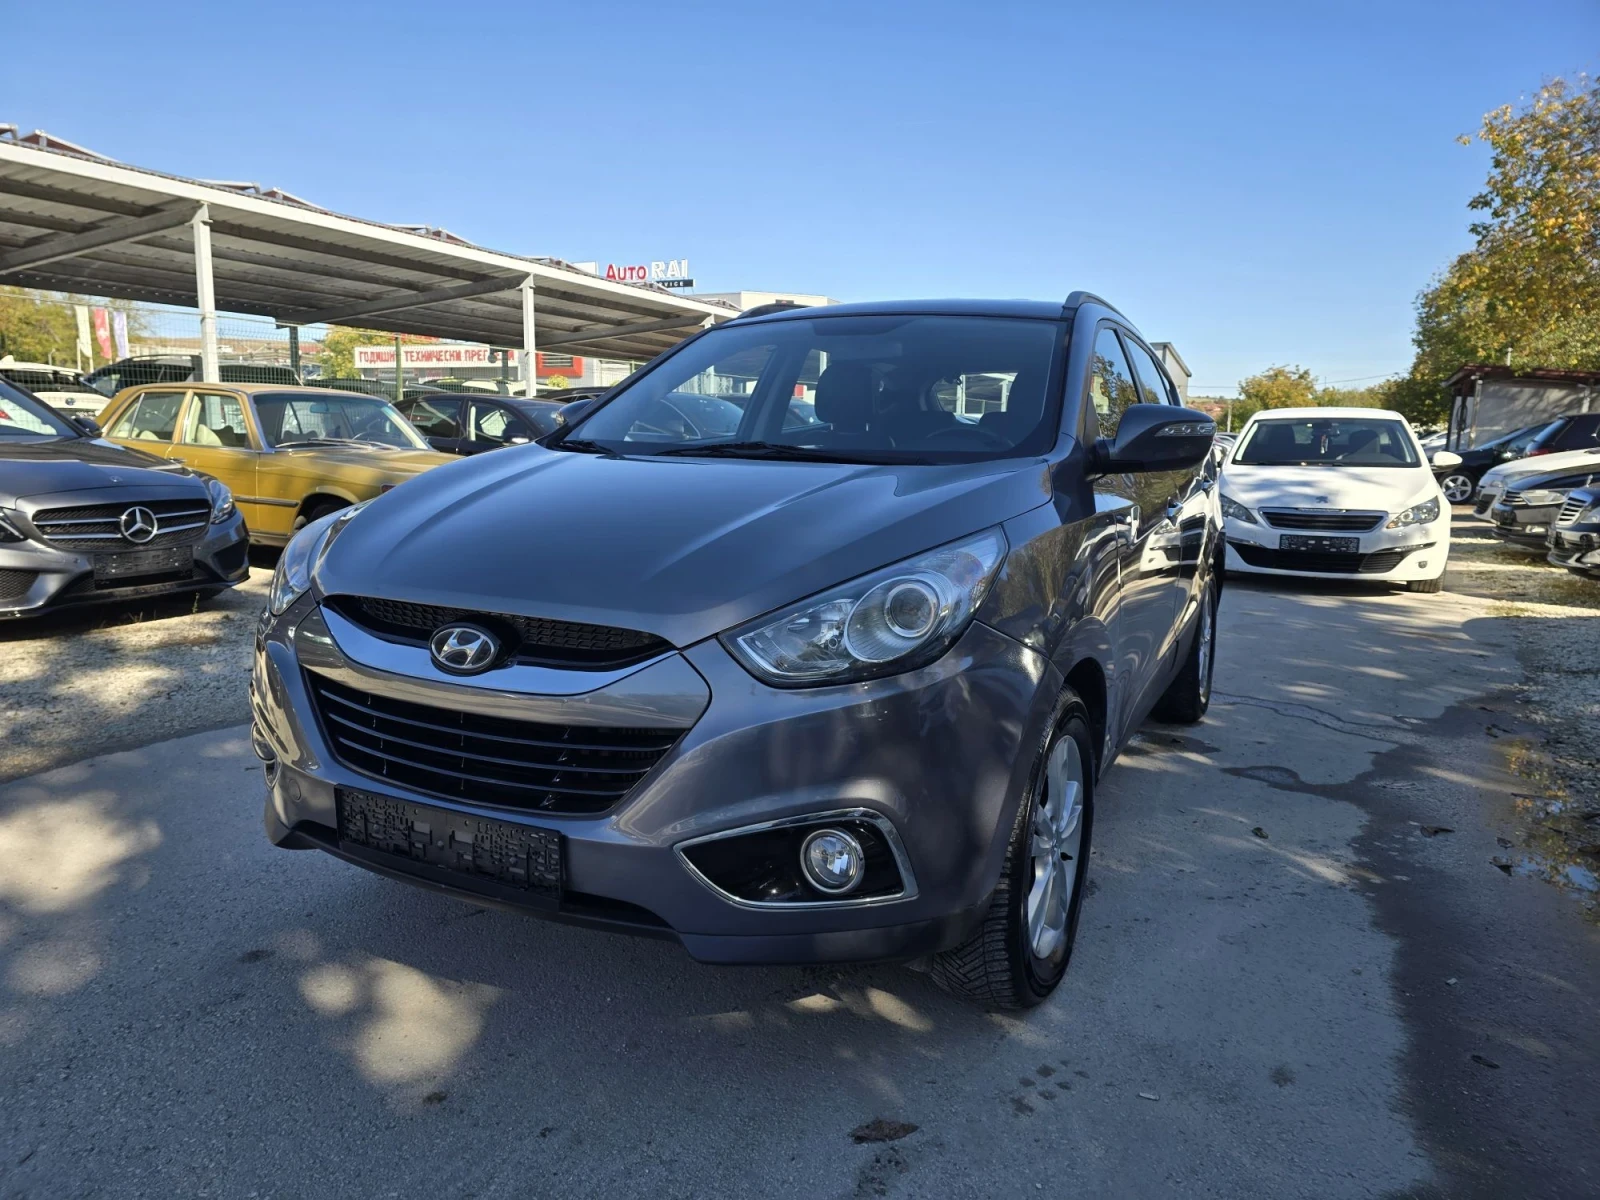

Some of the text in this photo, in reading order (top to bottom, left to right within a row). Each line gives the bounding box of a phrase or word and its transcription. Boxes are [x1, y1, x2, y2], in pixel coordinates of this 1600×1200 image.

[606, 259, 688, 281] AUTO RAI
[359, 350, 397, 364] ГОДИШН
